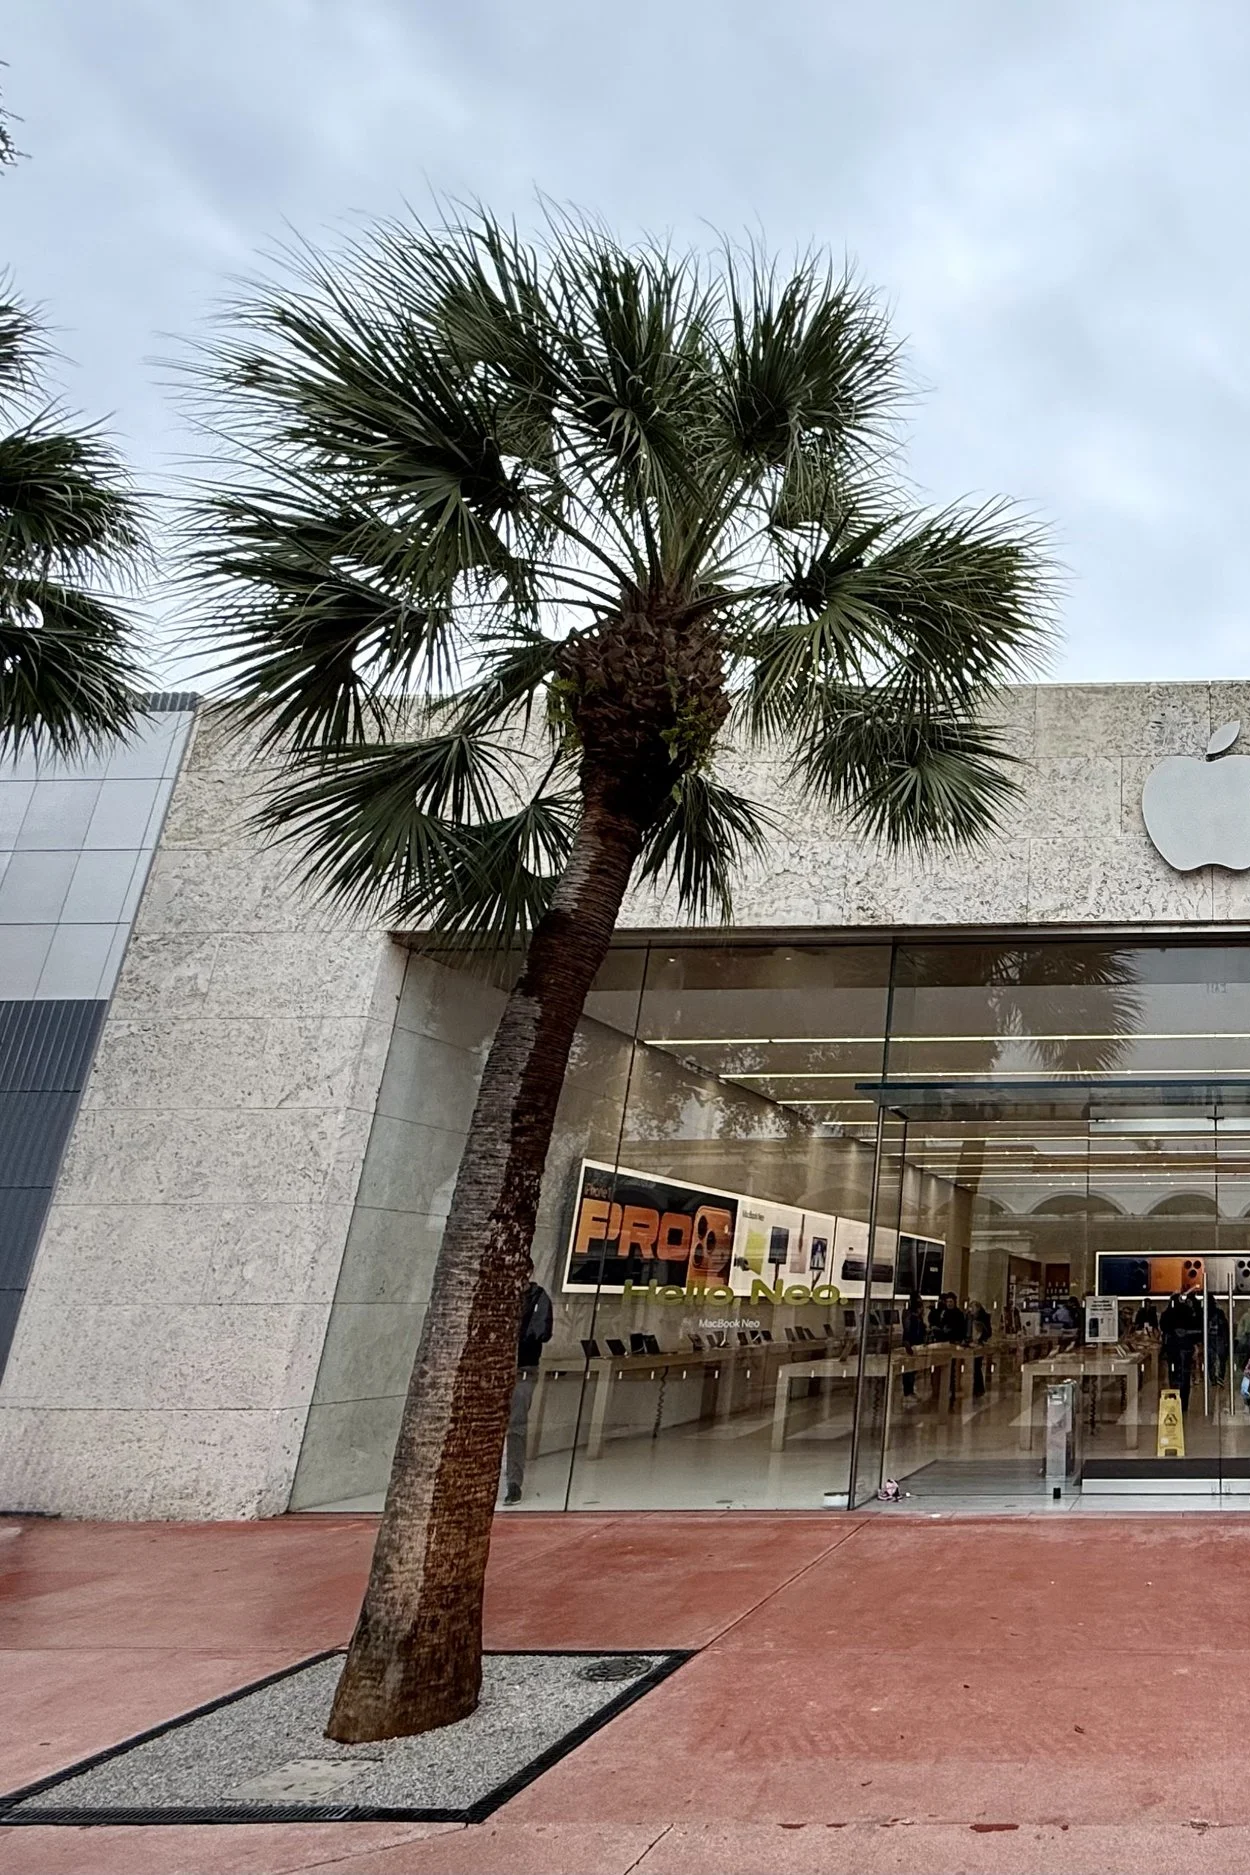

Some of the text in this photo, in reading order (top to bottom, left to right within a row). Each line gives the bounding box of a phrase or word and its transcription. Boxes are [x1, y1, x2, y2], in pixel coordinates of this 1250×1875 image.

[575, 1198, 692, 1261] PRO
[622, 1278, 849, 1309] Hello, Neo.
[699, 1319, 761, 1329] MacBook Neo
